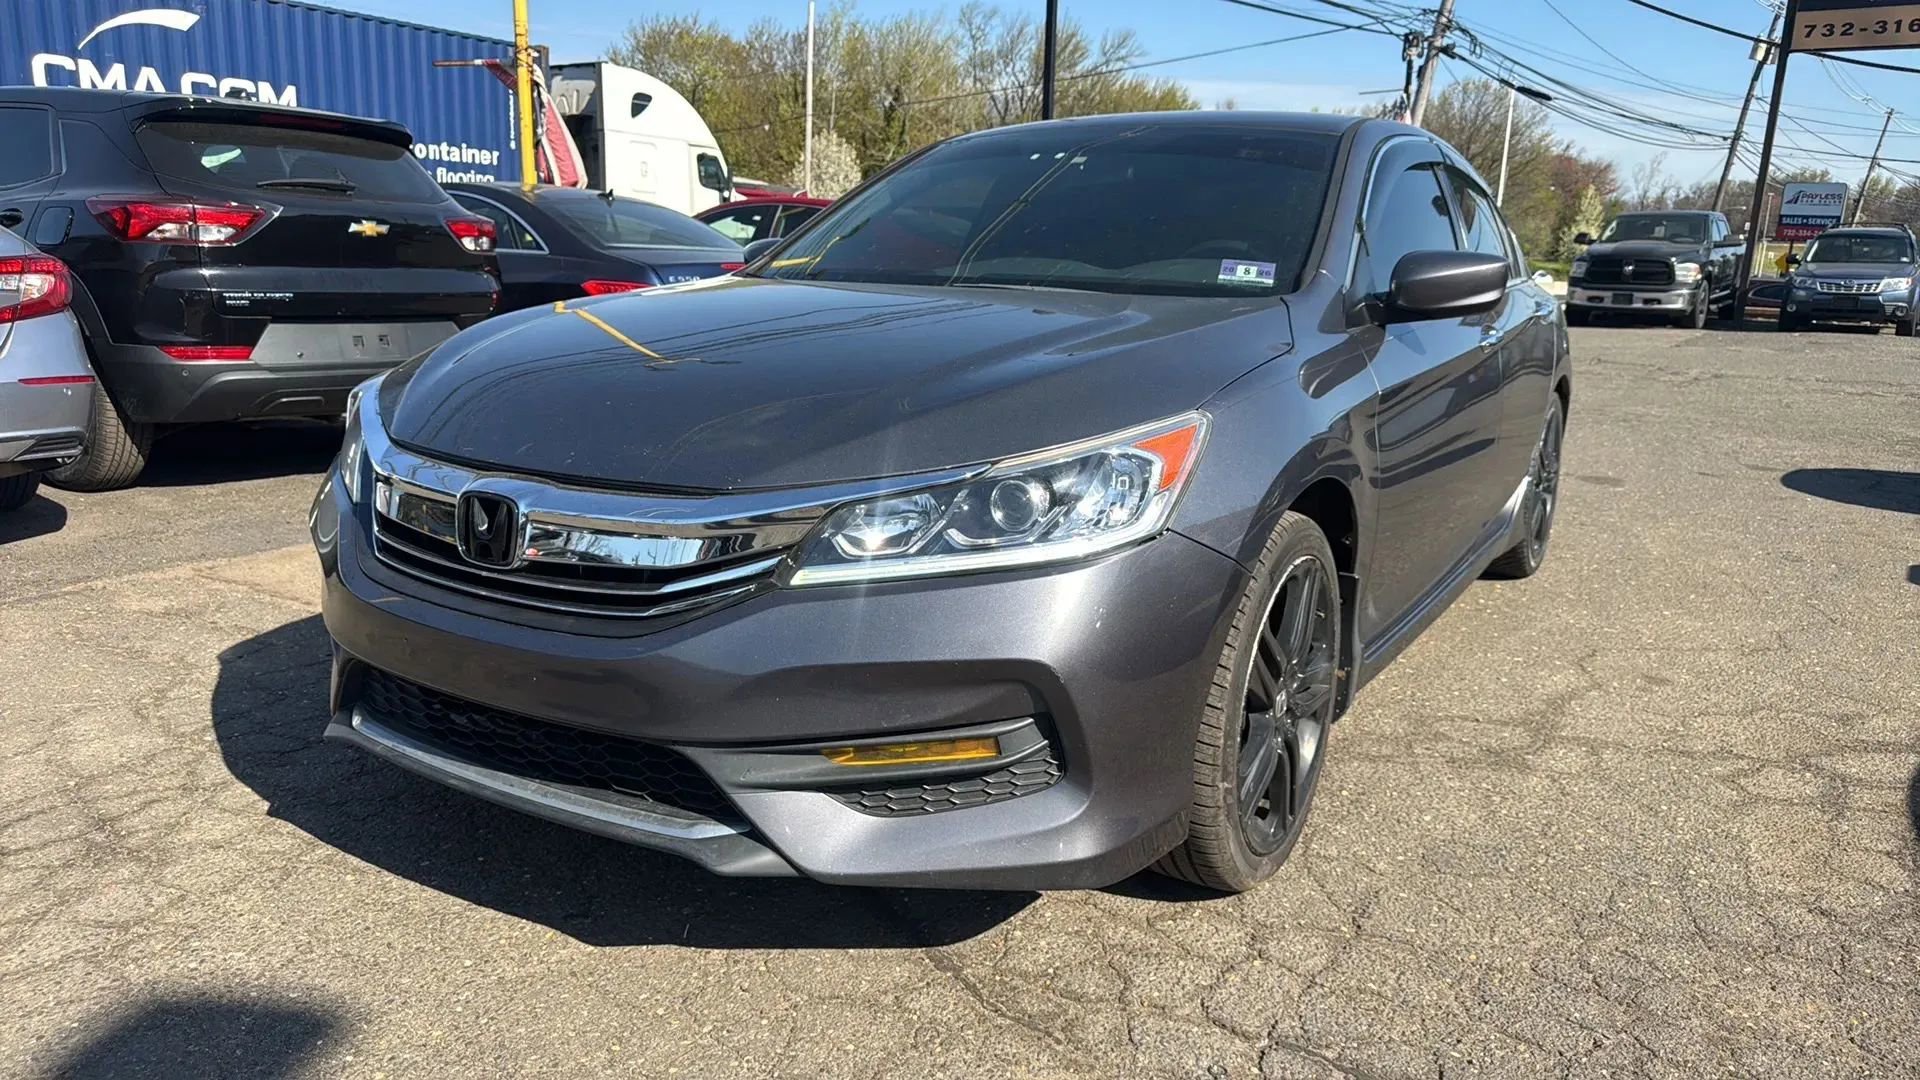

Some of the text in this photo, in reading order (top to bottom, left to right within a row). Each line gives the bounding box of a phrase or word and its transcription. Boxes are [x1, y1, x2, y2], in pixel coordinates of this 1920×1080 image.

[31, 53, 167, 92] CMA
[408, 141, 500, 166] ontainer
[1243, 267, 1251, 275] 8
